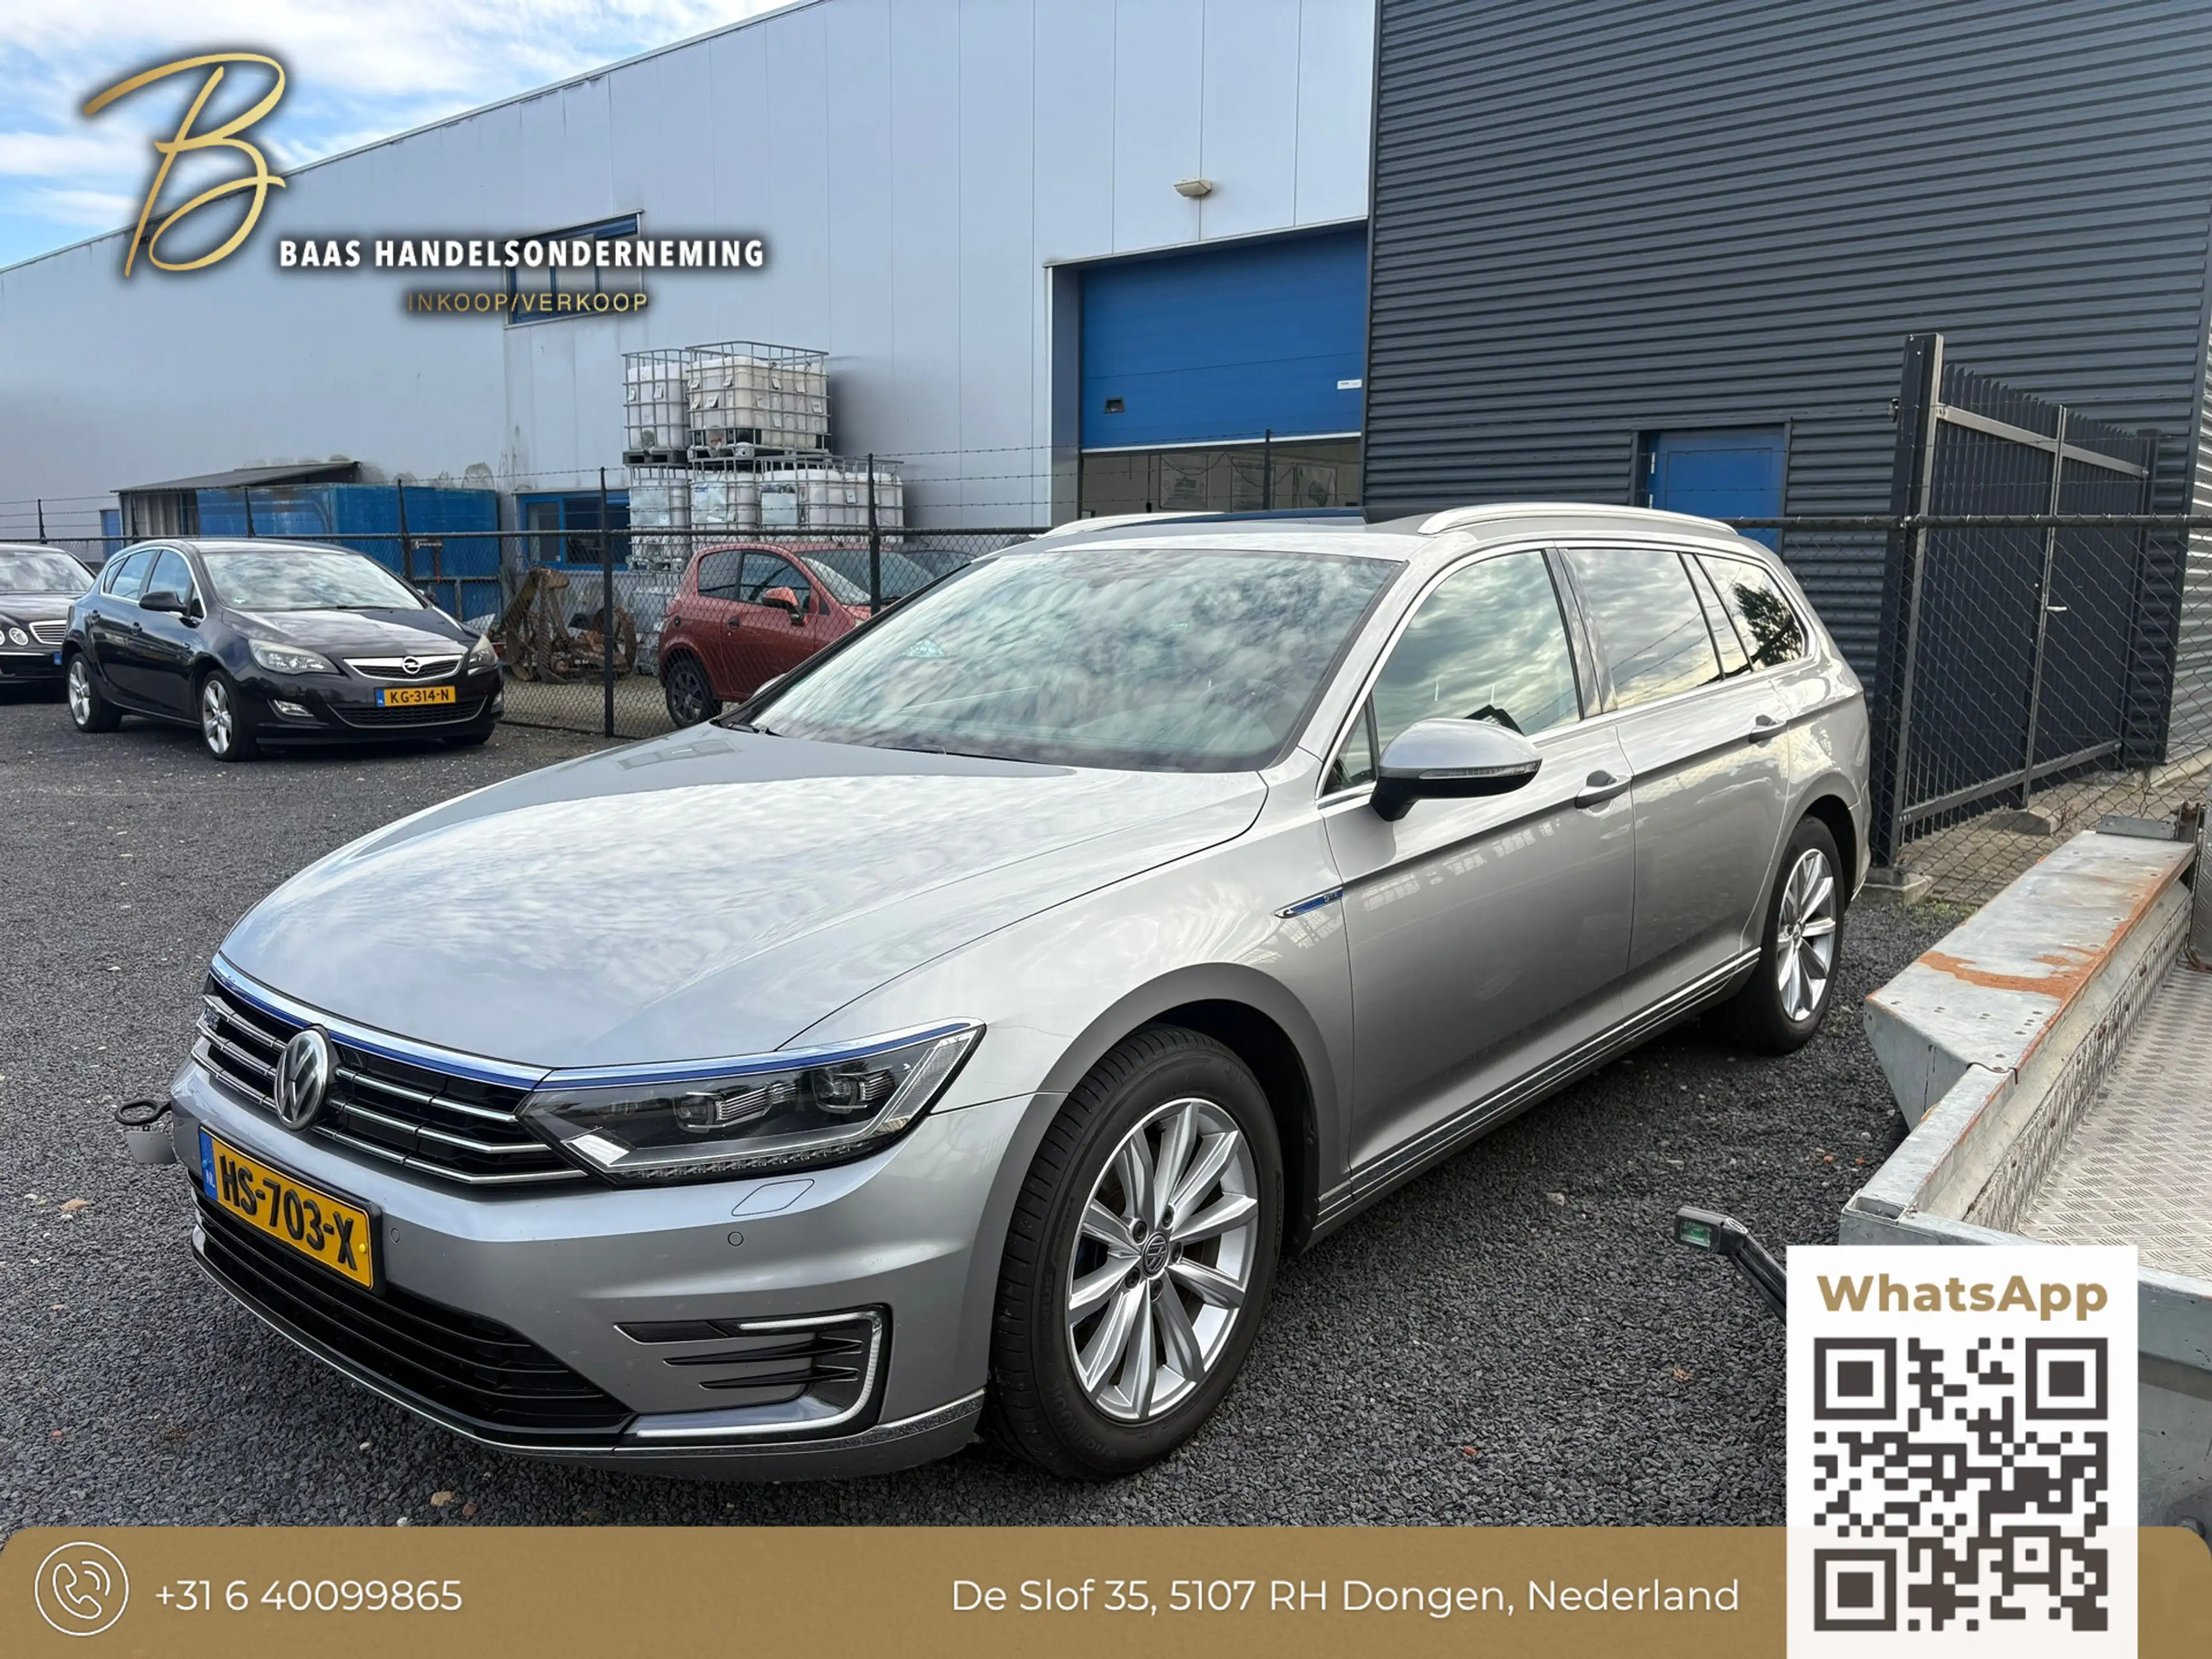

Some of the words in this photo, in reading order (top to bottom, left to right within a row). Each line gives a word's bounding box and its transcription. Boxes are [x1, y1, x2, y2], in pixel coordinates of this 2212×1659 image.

[390, 688, 449, 703] KG-314-N
[205, 1169, 217, 1188] NL
[219, 1154, 358, 1271] HS-703-X
